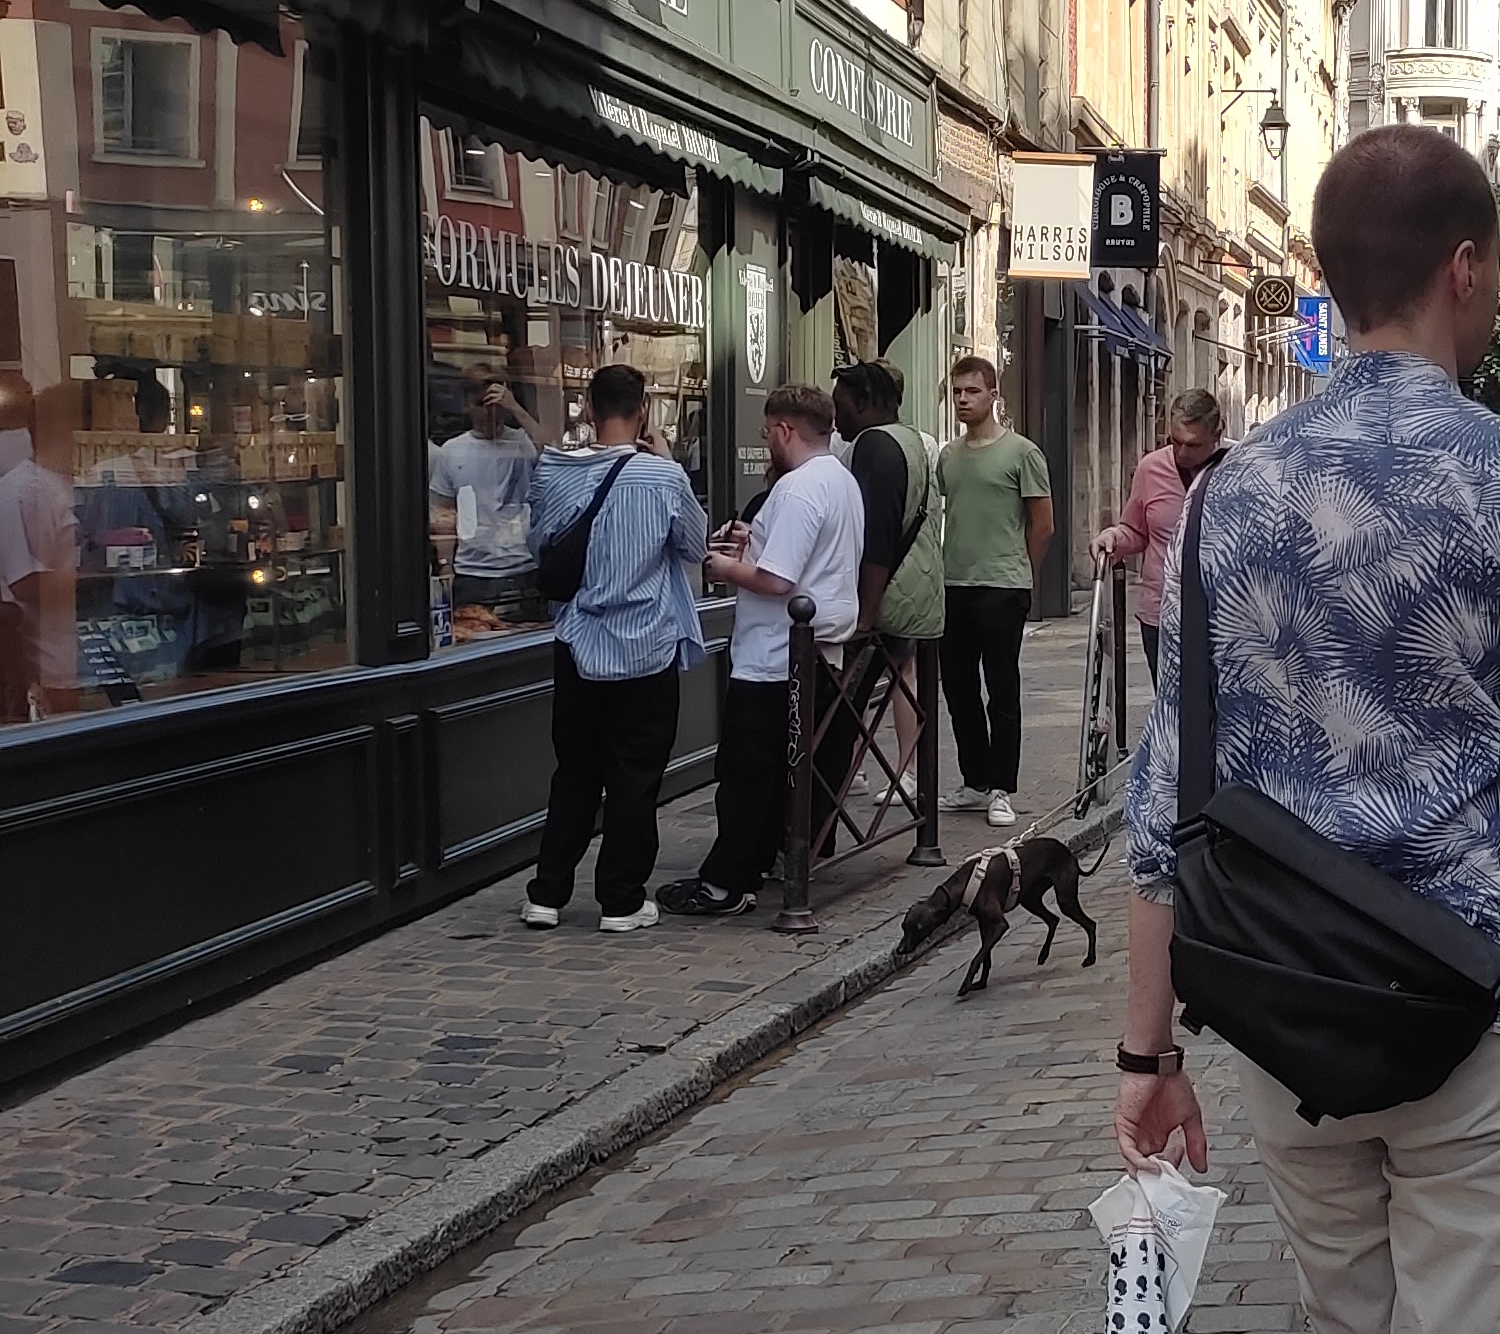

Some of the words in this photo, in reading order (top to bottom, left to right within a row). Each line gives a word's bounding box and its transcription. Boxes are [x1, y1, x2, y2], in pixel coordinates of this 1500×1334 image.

[810, 38, 913, 147] CONFISERIE
[1111, 194, 1134, 226] B
[1014, 225, 1087, 244] HARRIS
[1014, 242, 1088, 262] WILSON
